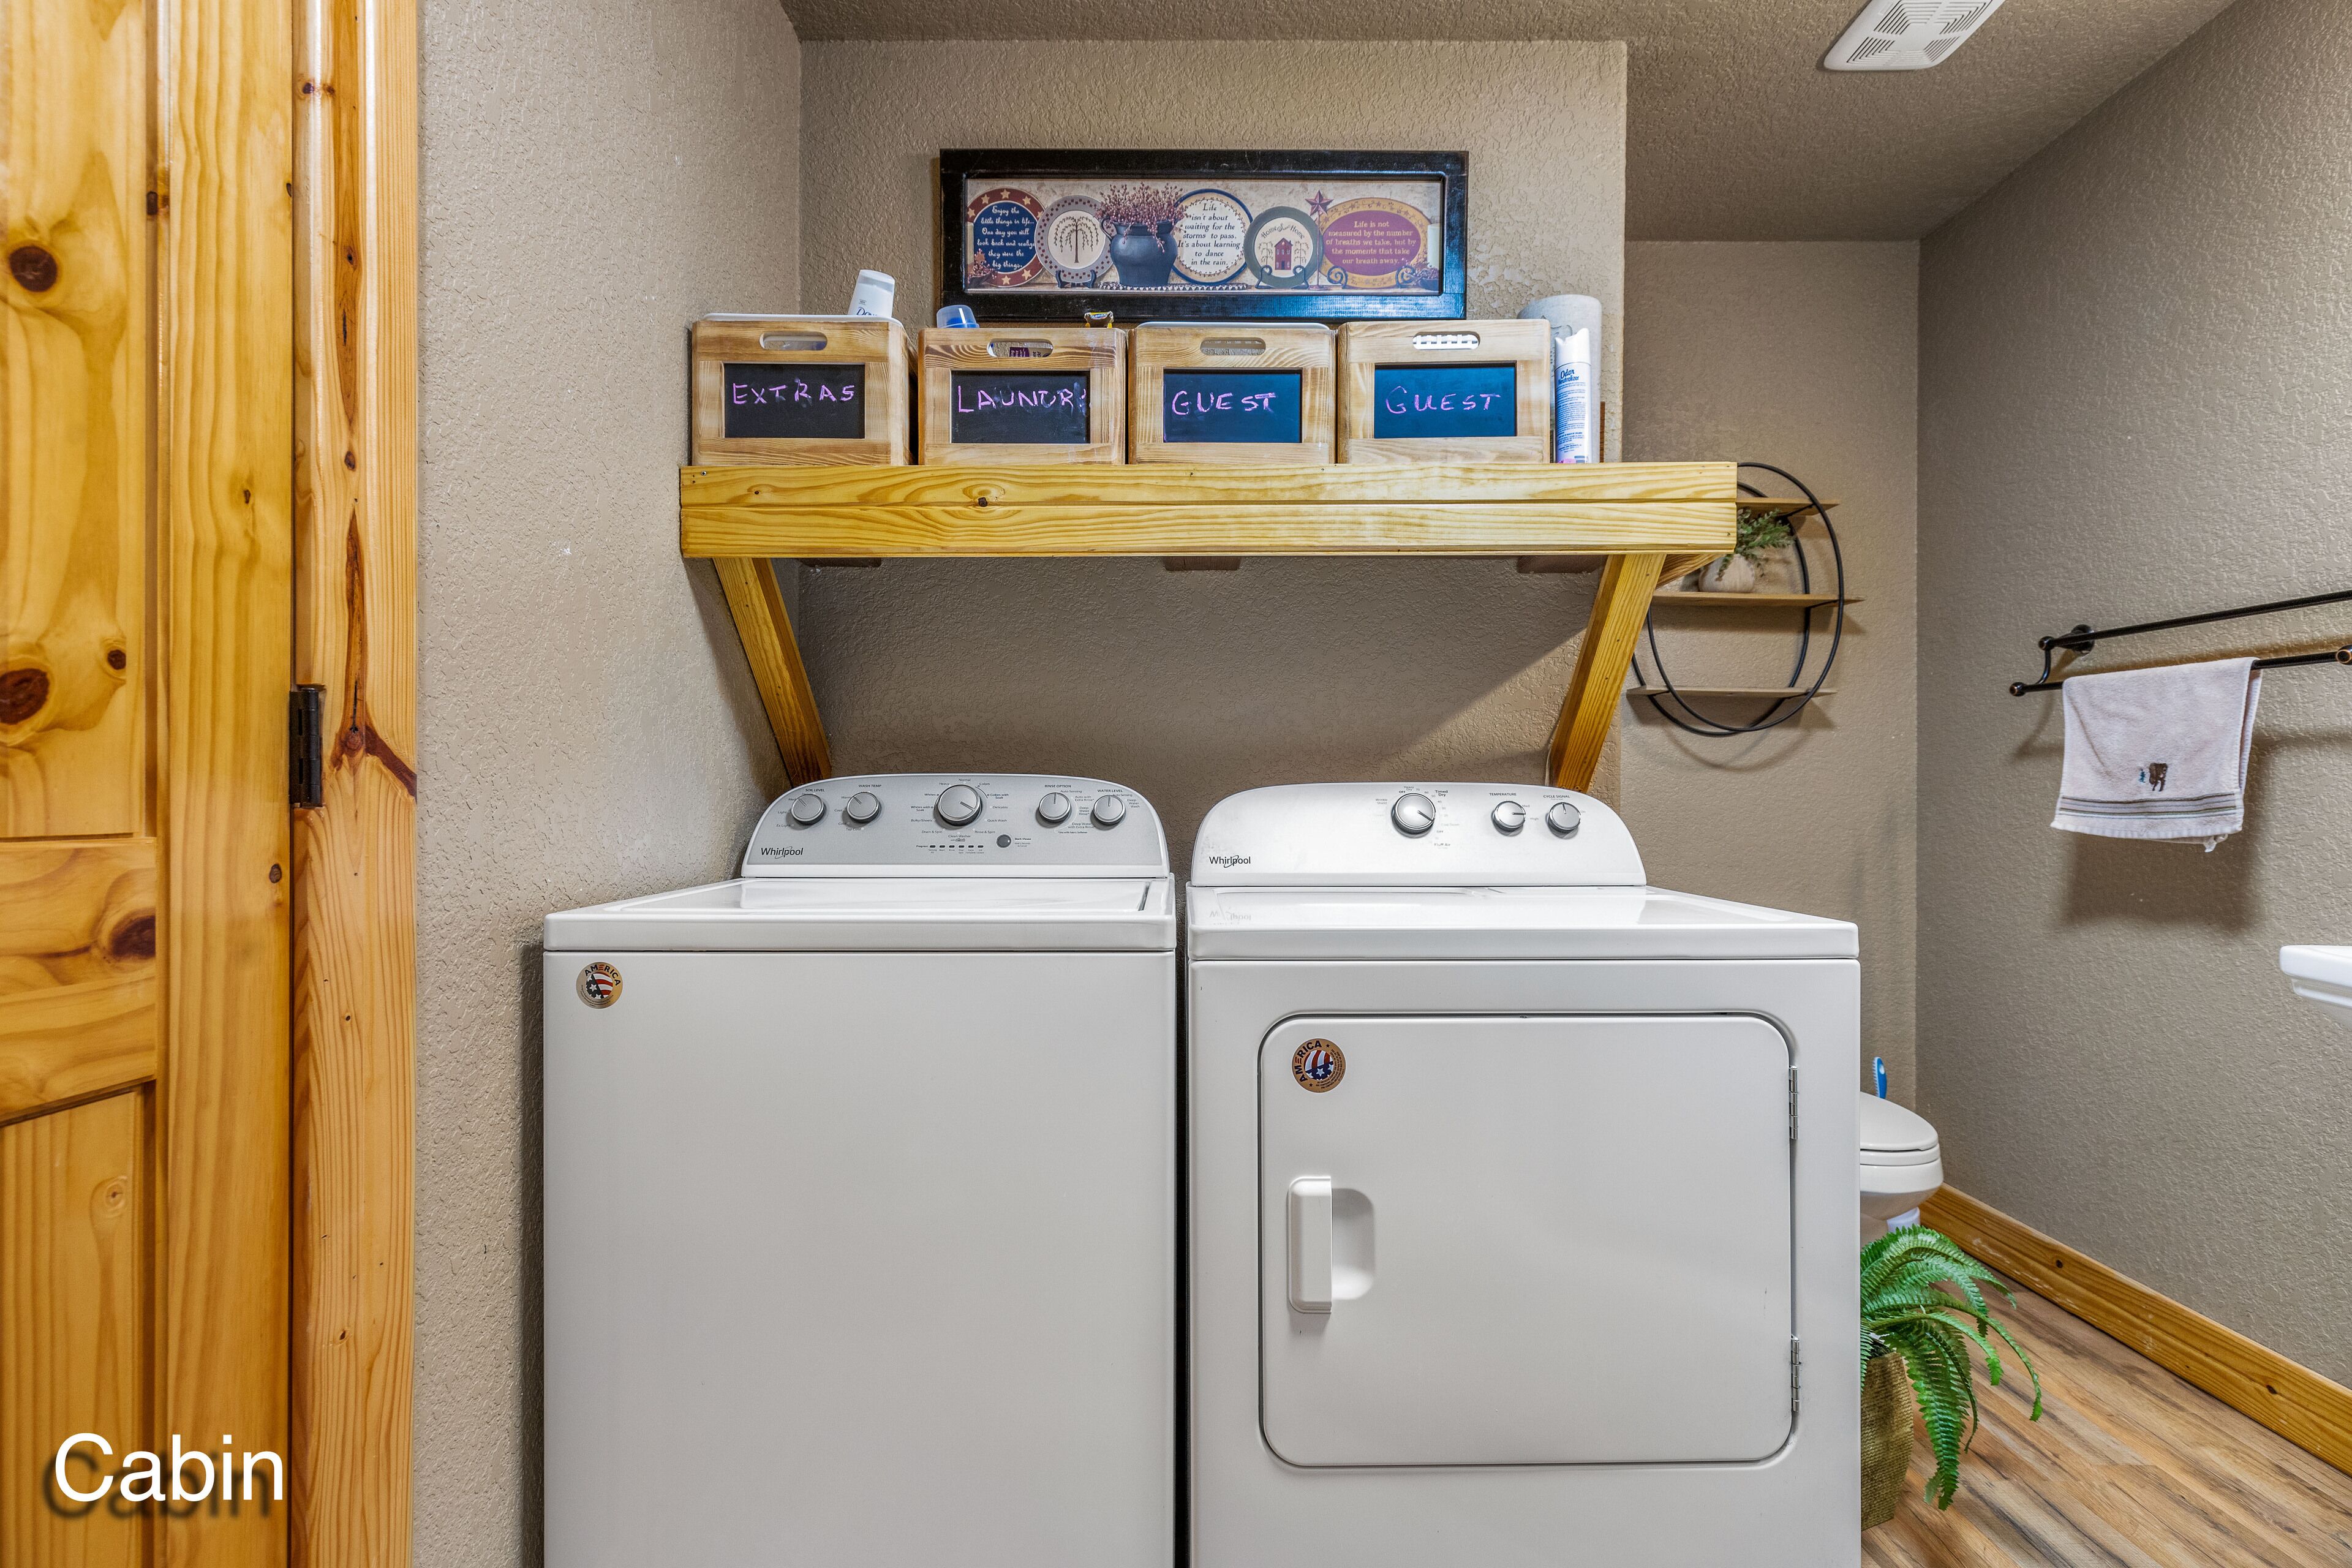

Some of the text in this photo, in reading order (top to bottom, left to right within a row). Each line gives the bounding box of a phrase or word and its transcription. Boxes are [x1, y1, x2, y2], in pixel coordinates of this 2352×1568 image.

[992, 206, 1009, 216] Enjoy
[996, 217, 1012, 226] things
[1185, 223, 1210, 232] waiting
[1261, 226, 1277, 238] Home
[1290, 225, 1305, 239] Home
[995, 229, 1005, 237] day
[1214, 240, 1240, 249] learning
[988, 250, 1000, 258] they
[992, 260, 1022, 270] big things.
[1561, 369, 1574, 379] Odor
[1558, 376, 1579, 385] Neutralizer
[733, 382, 855, 404] EXTRAS
[1172, 390, 1276, 415] GUEST
[1385, 386, 1501, 414] GUEST
[761, 847, 803, 858] Whirlpool
[1209, 856, 1251, 867] Whirlpool
[585, 964, 621, 986] AMERICA
[1294, 1040, 1322, 1082] AMERICA
